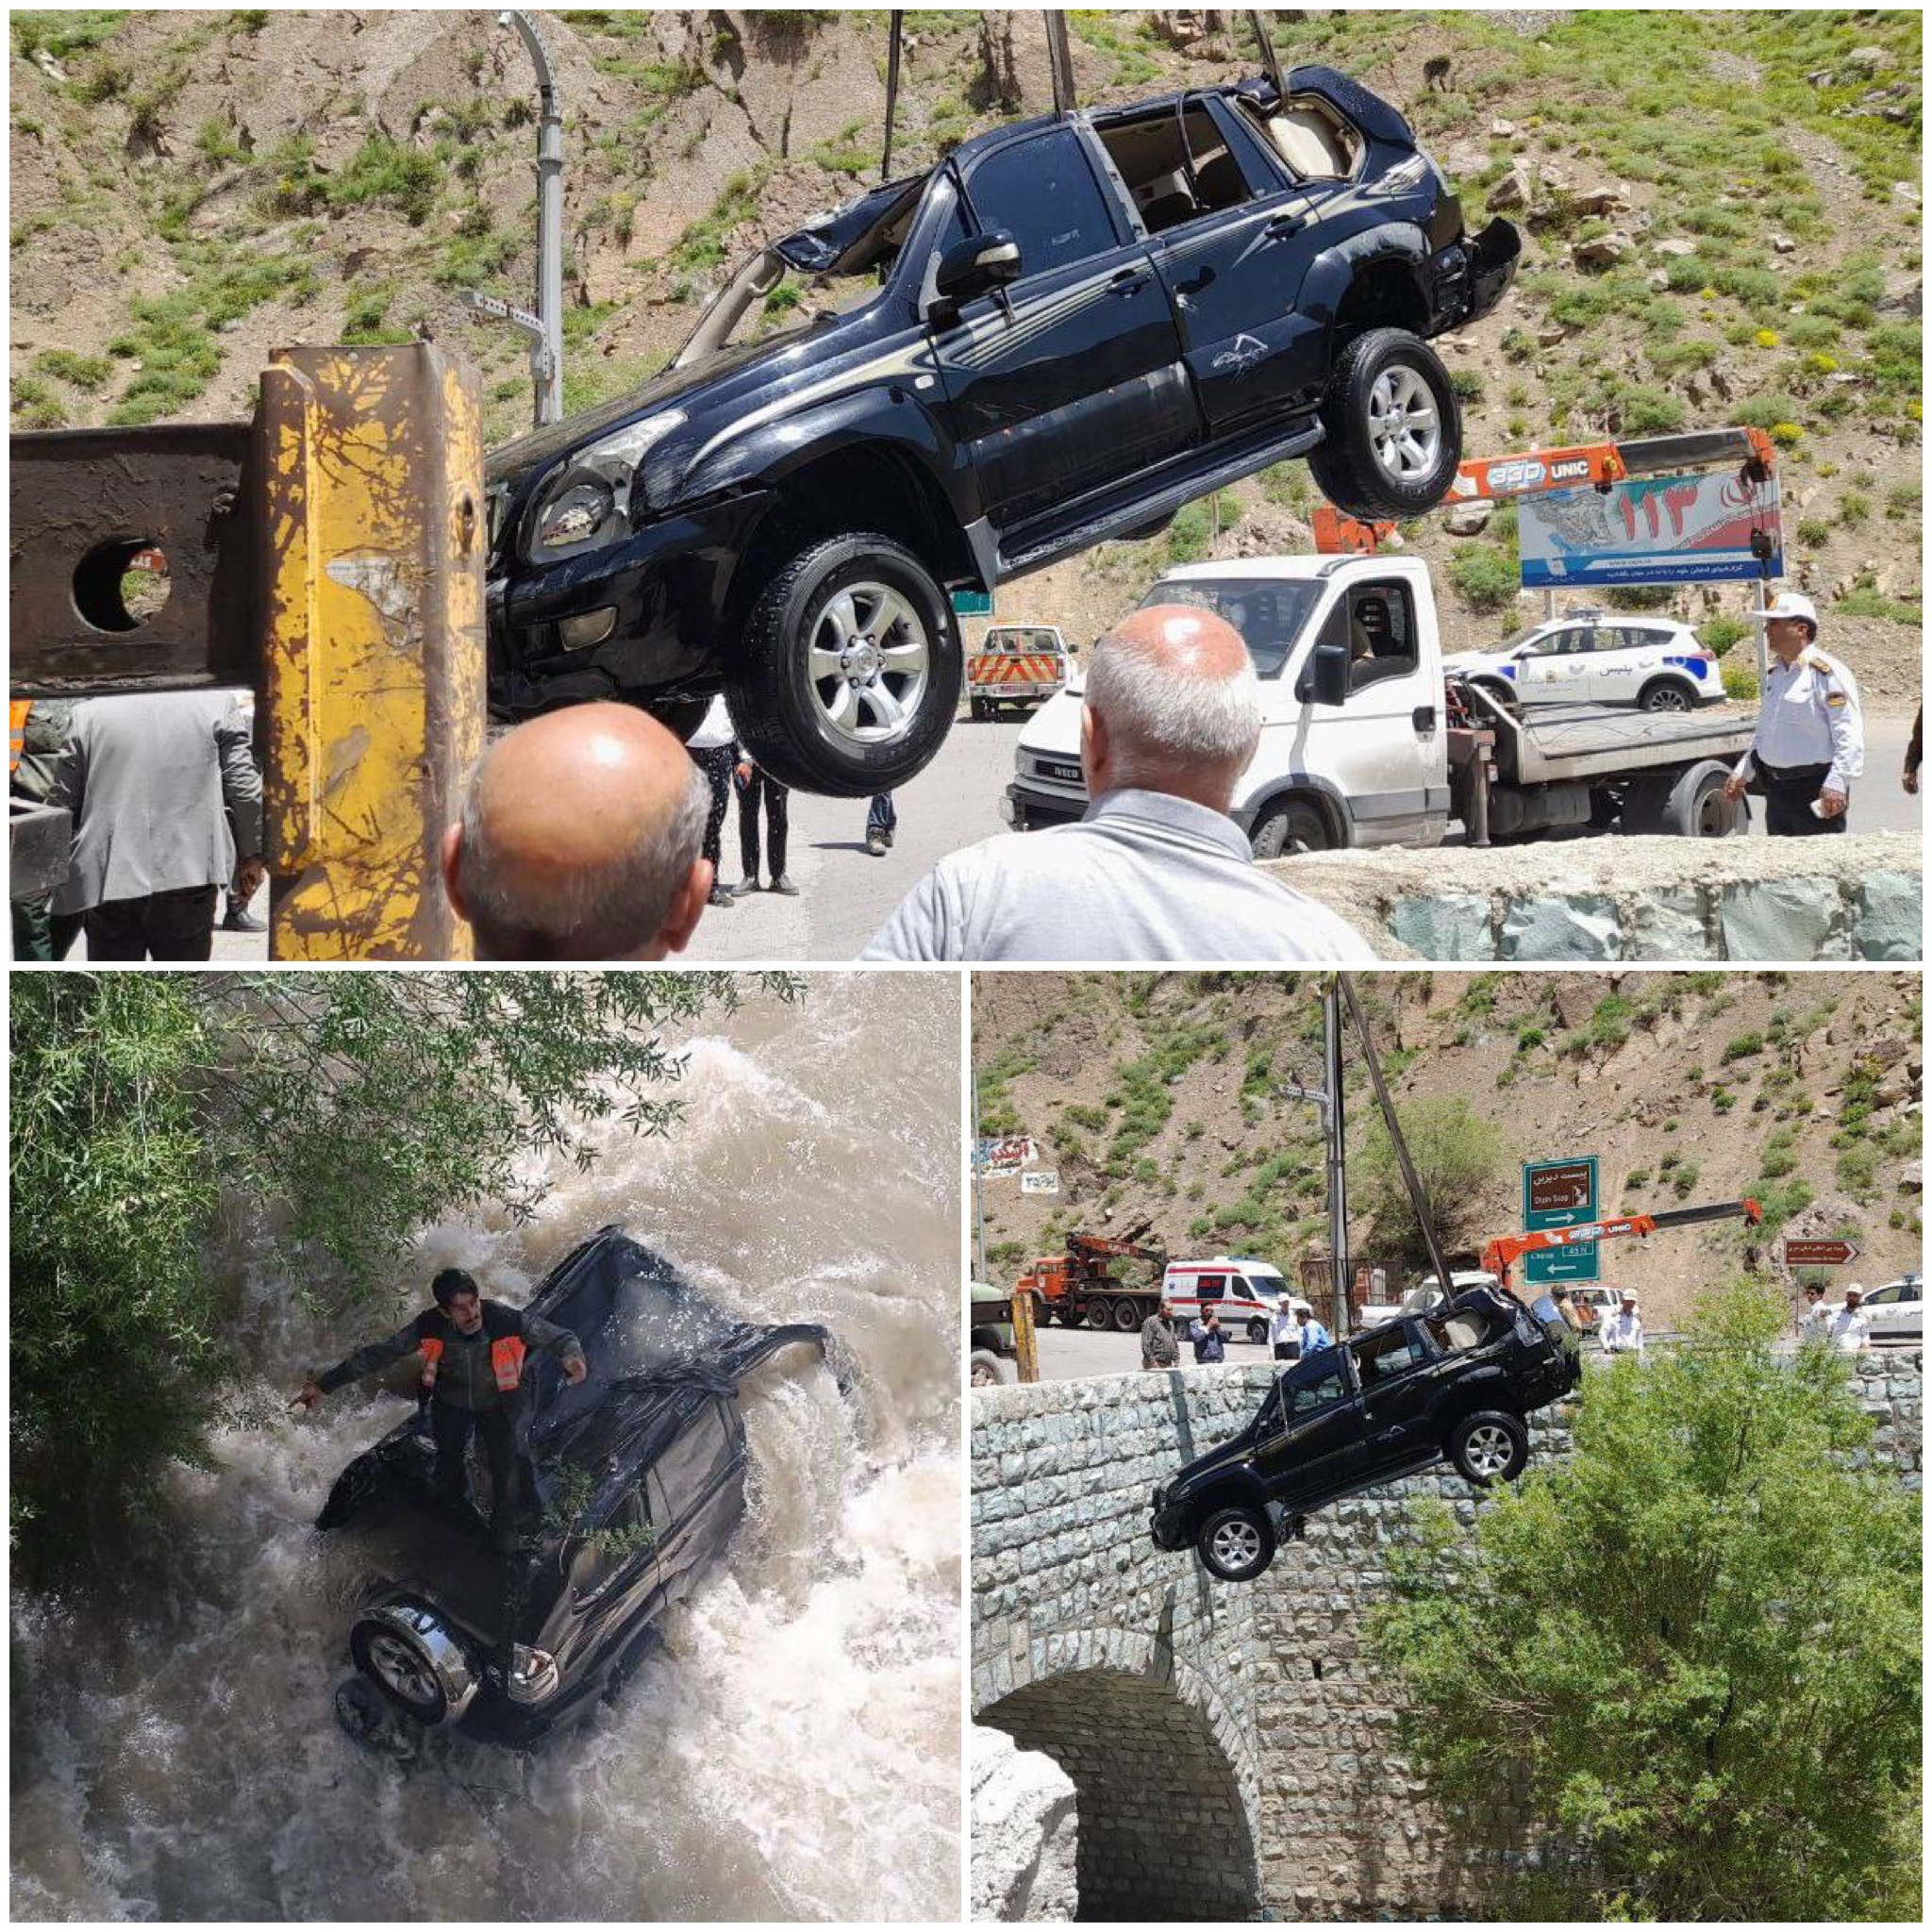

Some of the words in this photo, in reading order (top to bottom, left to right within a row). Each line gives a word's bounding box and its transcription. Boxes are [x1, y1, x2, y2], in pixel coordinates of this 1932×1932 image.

[1551, 461, 1589, 478] UNIC
[1619, 484, 1699, 541] ۱۱۳
[1600, 665, 1632, 676] پلیس
[1054, 766, 1078, 778] IVECO
[1533, 1174, 1558, 1186] دیزین
[1559, 1171, 1587, 1181] پیست
[1608, 1224, 1631, 1233] UNIC
